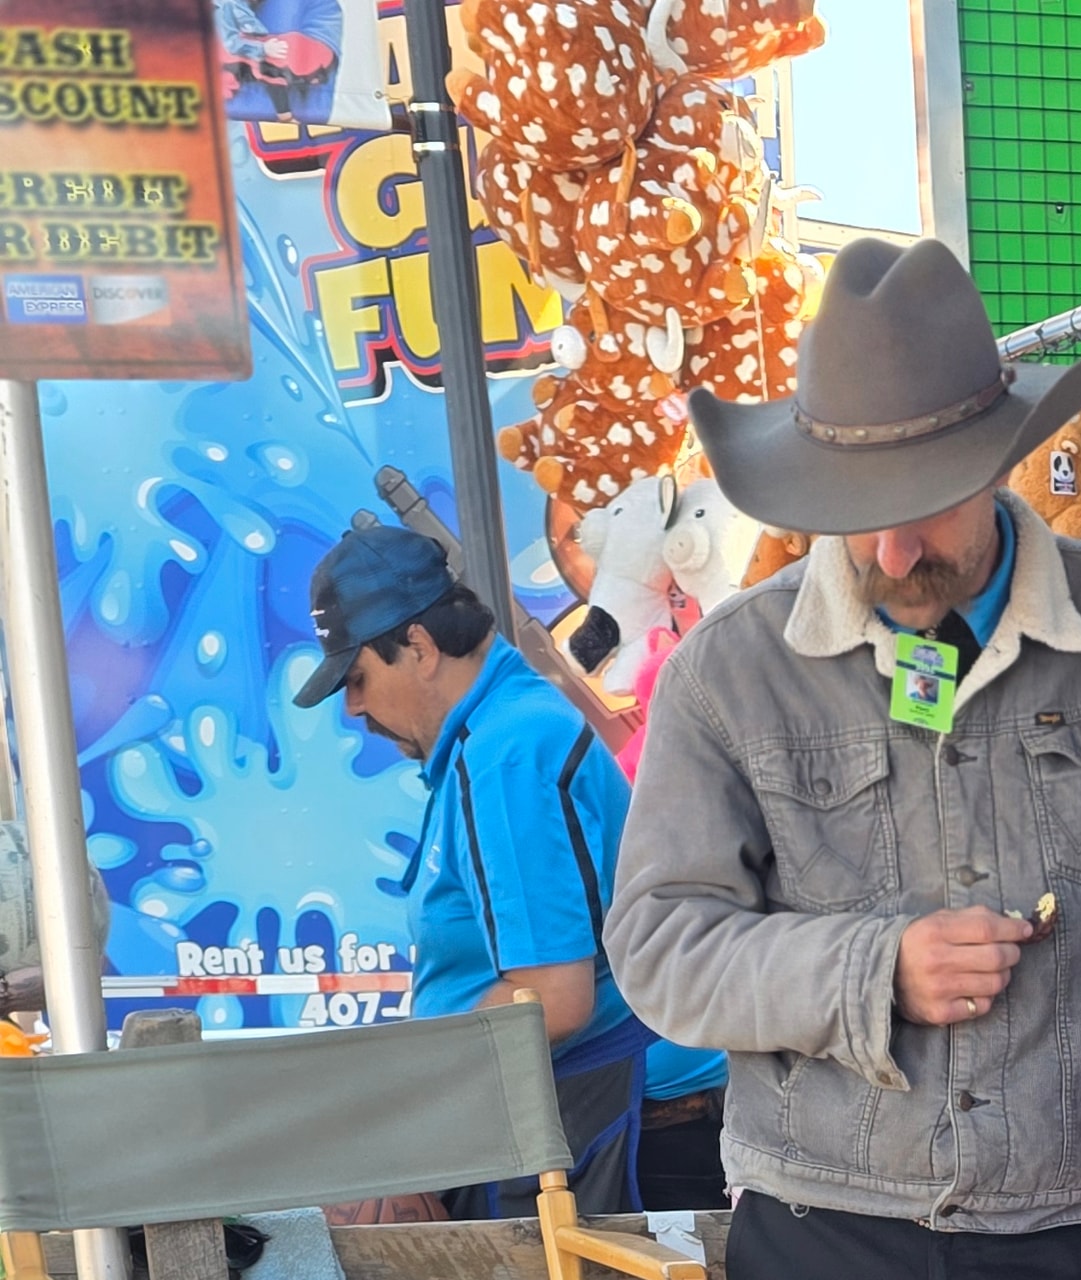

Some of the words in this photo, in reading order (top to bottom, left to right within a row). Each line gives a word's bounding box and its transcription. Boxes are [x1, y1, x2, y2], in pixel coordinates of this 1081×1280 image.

[0, 27, 132, 71] ASH
[0, 172, 187, 212] REDIT
[44, 221, 218, 263] DEBIT
[8, 281, 77, 298] AMERICAN
[24, 301, 84, 314] EXPRESS
[92, 286, 164, 301] DISCOVER
[176, 937, 264, 976] Rent
[278, 944, 326, 975] us
[339, 933, 396, 972] for
